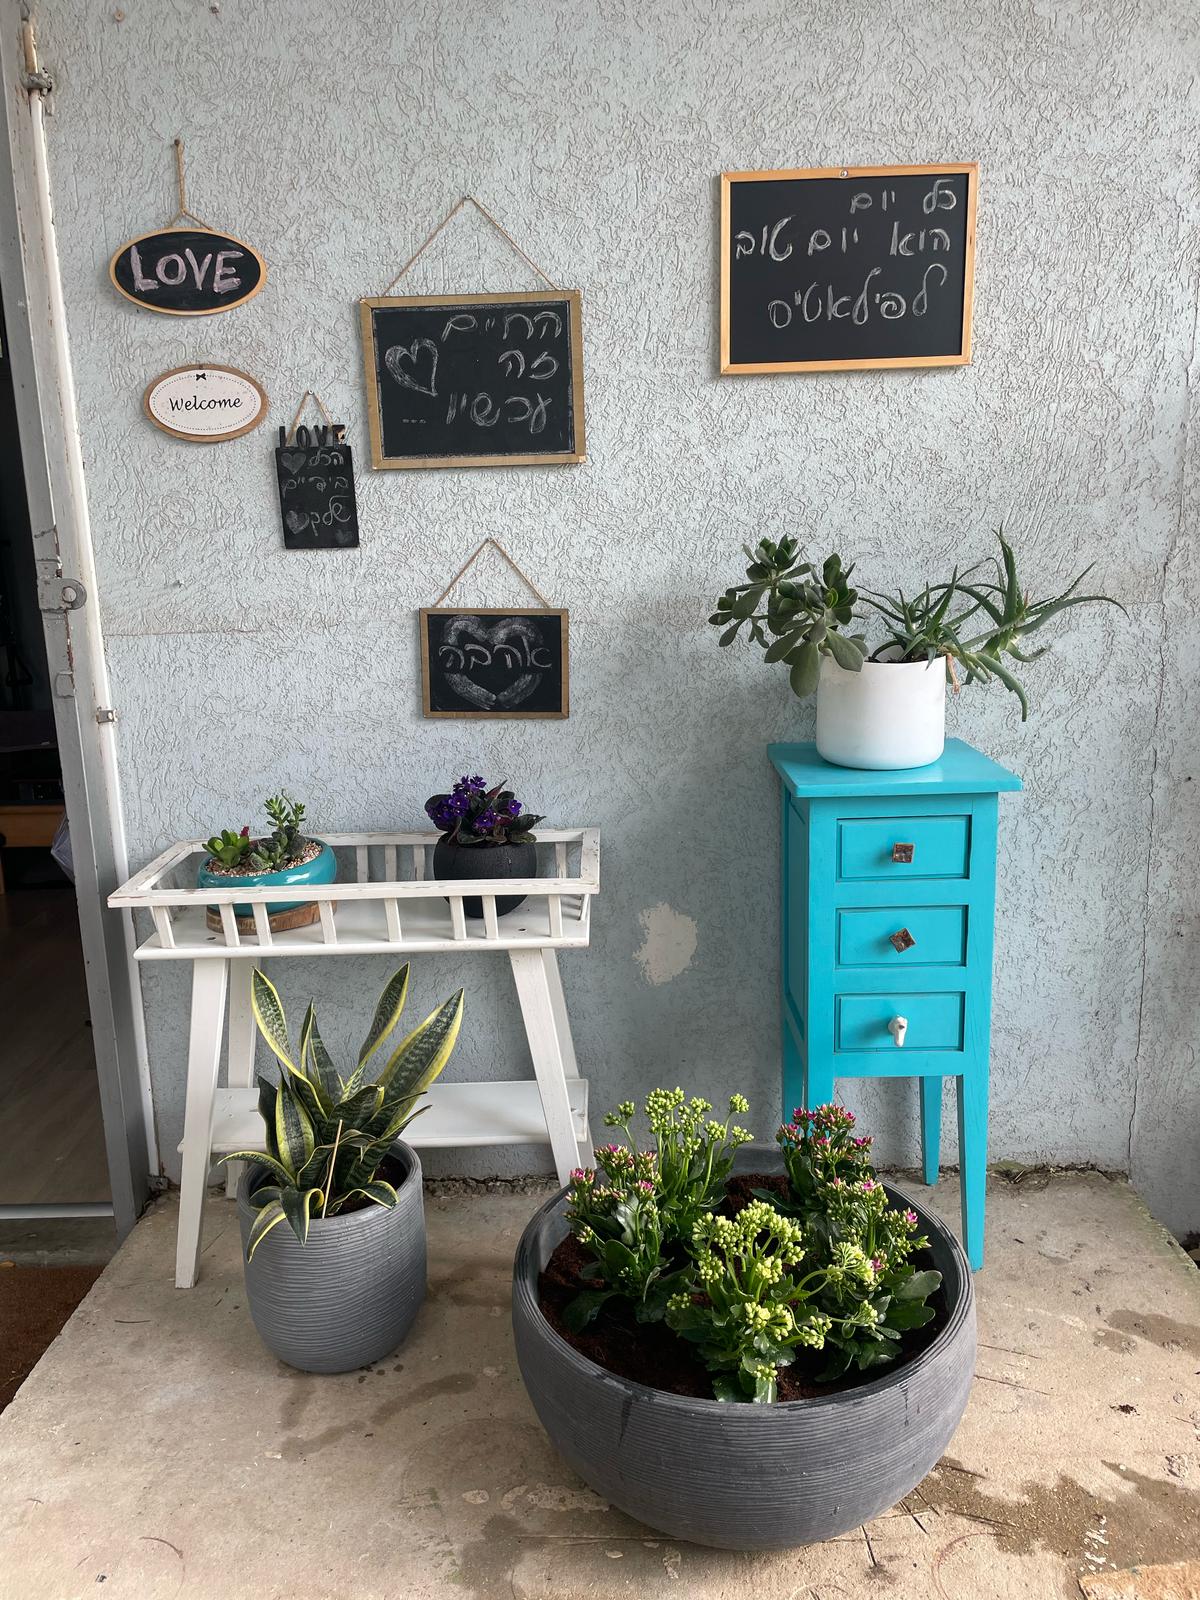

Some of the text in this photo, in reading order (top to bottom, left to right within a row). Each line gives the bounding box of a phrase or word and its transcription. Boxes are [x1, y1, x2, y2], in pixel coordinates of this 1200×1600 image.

[849, 179, 957, 214] כל יום
[734, 214, 951, 262] הוא יום טוב
[130, 245, 245, 295] LOVE
[767, 263, 948, 329] לפילאטיס
[441, 311, 563, 343] החיים
[168, 395, 244, 412] Welcome
[446, 391, 553, 434] עכשיו
[308, 447, 345, 467] הכל
[310, 495, 352, 537] שלך
[438, 635, 553, 671] אהבה
